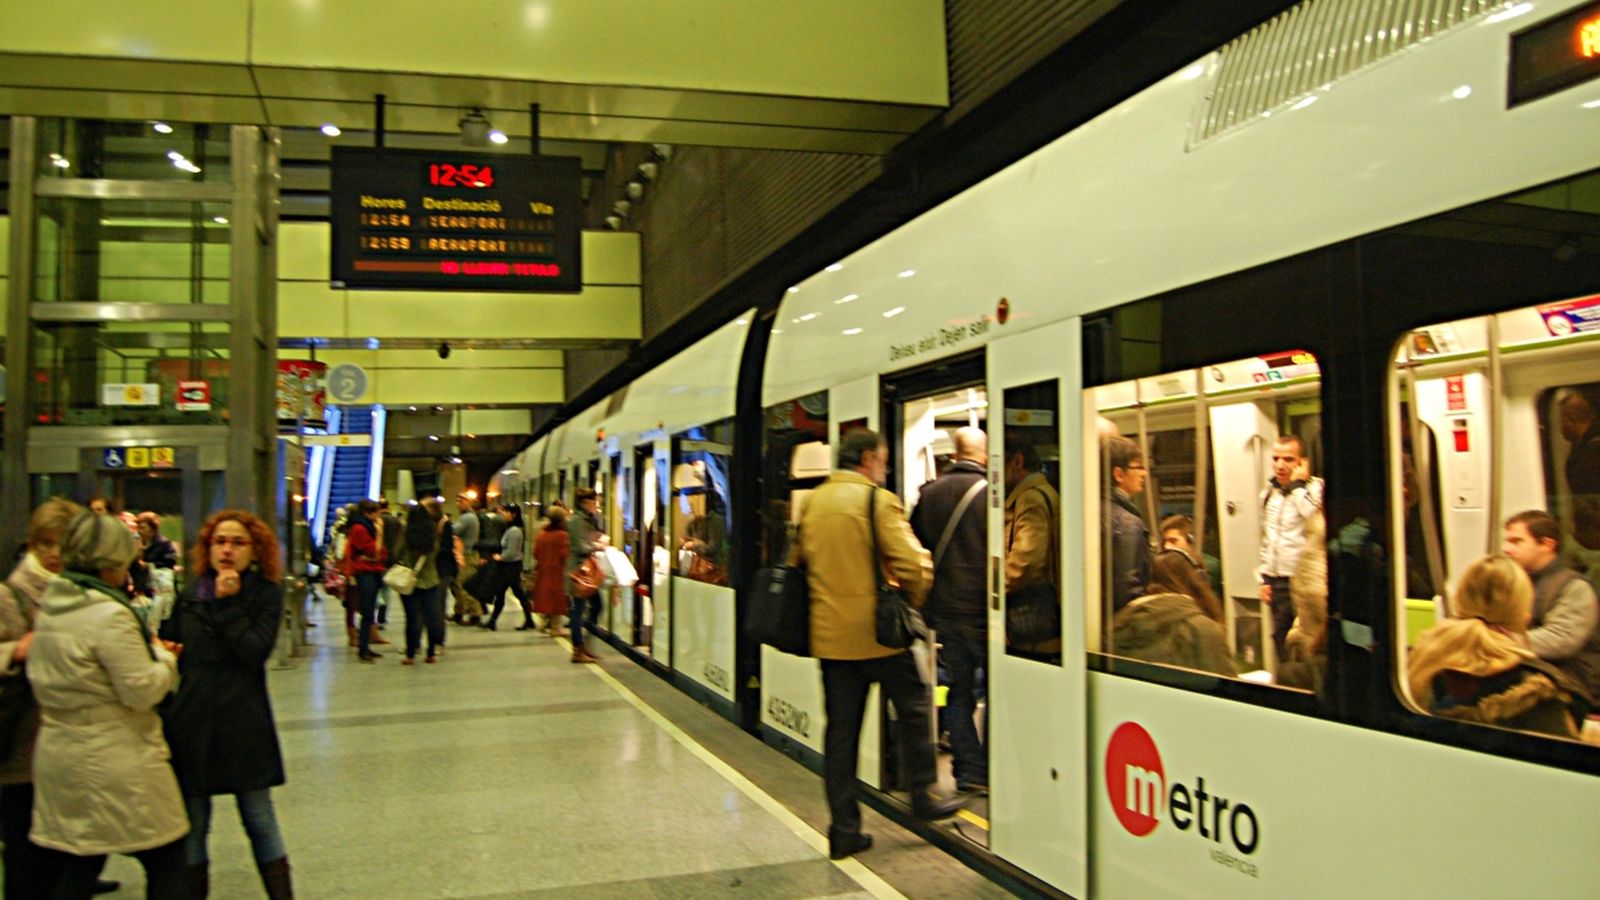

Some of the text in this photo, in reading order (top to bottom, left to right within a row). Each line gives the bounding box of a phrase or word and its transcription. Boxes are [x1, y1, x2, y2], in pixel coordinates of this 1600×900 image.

[429, 163, 494, 188] 12:54
[361, 195, 407, 210] Hores
[423, 197, 502, 213] Destinació
[361, 213, 411, 227] 12:54
[339, 378, 357, 399] 2
[1126, 763, 1260, 855] metro
